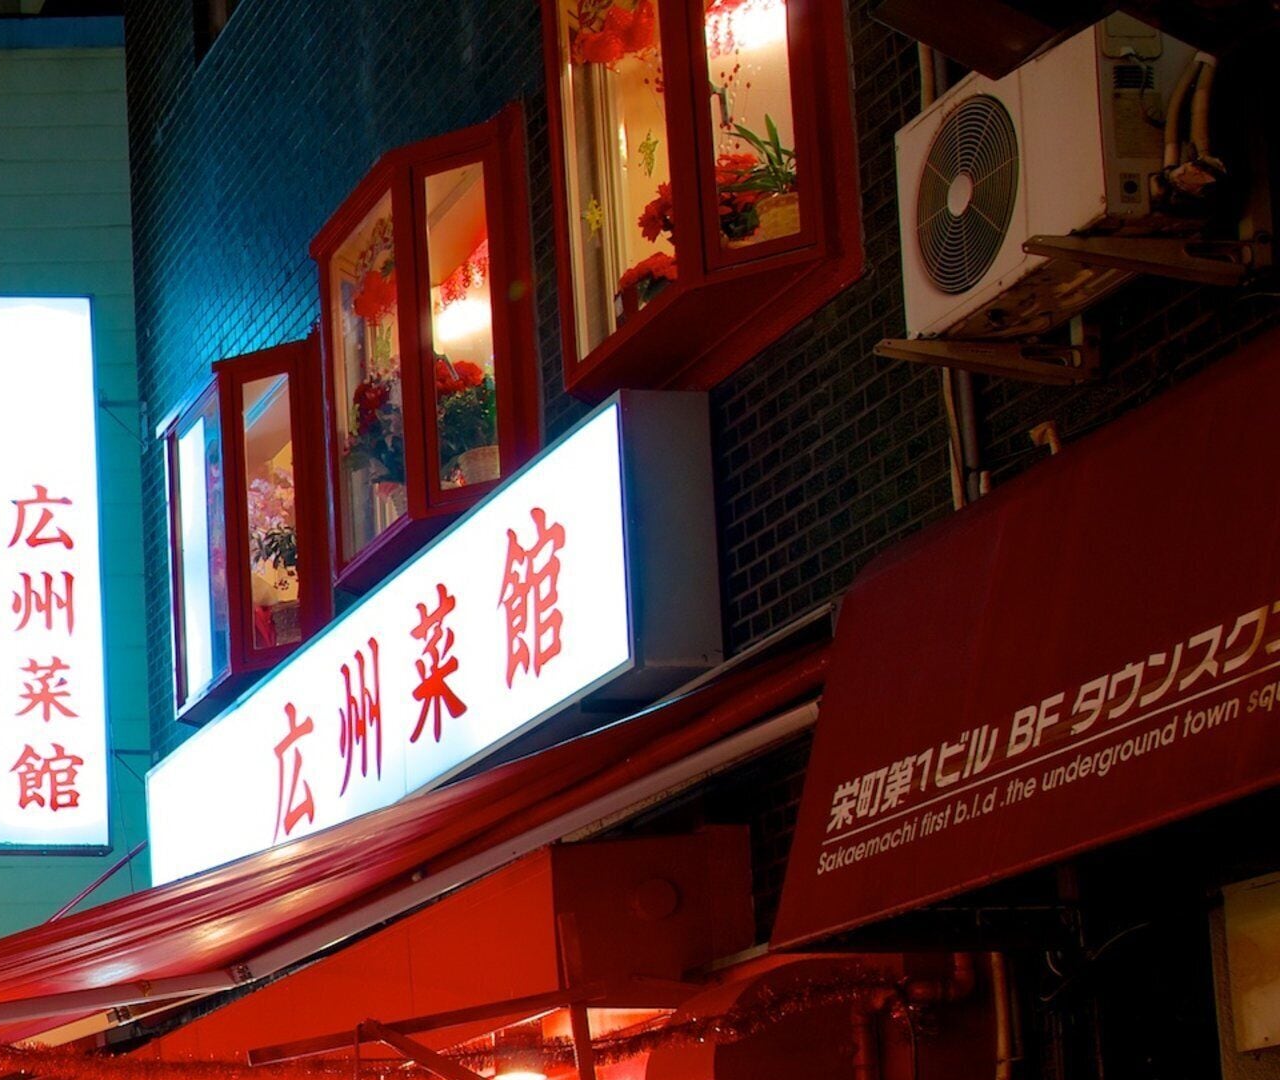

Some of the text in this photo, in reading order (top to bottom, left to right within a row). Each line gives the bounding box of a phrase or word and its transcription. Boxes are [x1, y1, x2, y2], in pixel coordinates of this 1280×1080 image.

[7, 484, 86, 812] 広州菜館
[272, 507, 566, 844] 広州菜館
[1006, 691, 1065, 758] BF
[817, 818, 918, 876] Sakaemachi
[919, 806, 952, 839] first
[1041, 715, 1179, 790] underground
[1182, 694, 1240, 739] town
